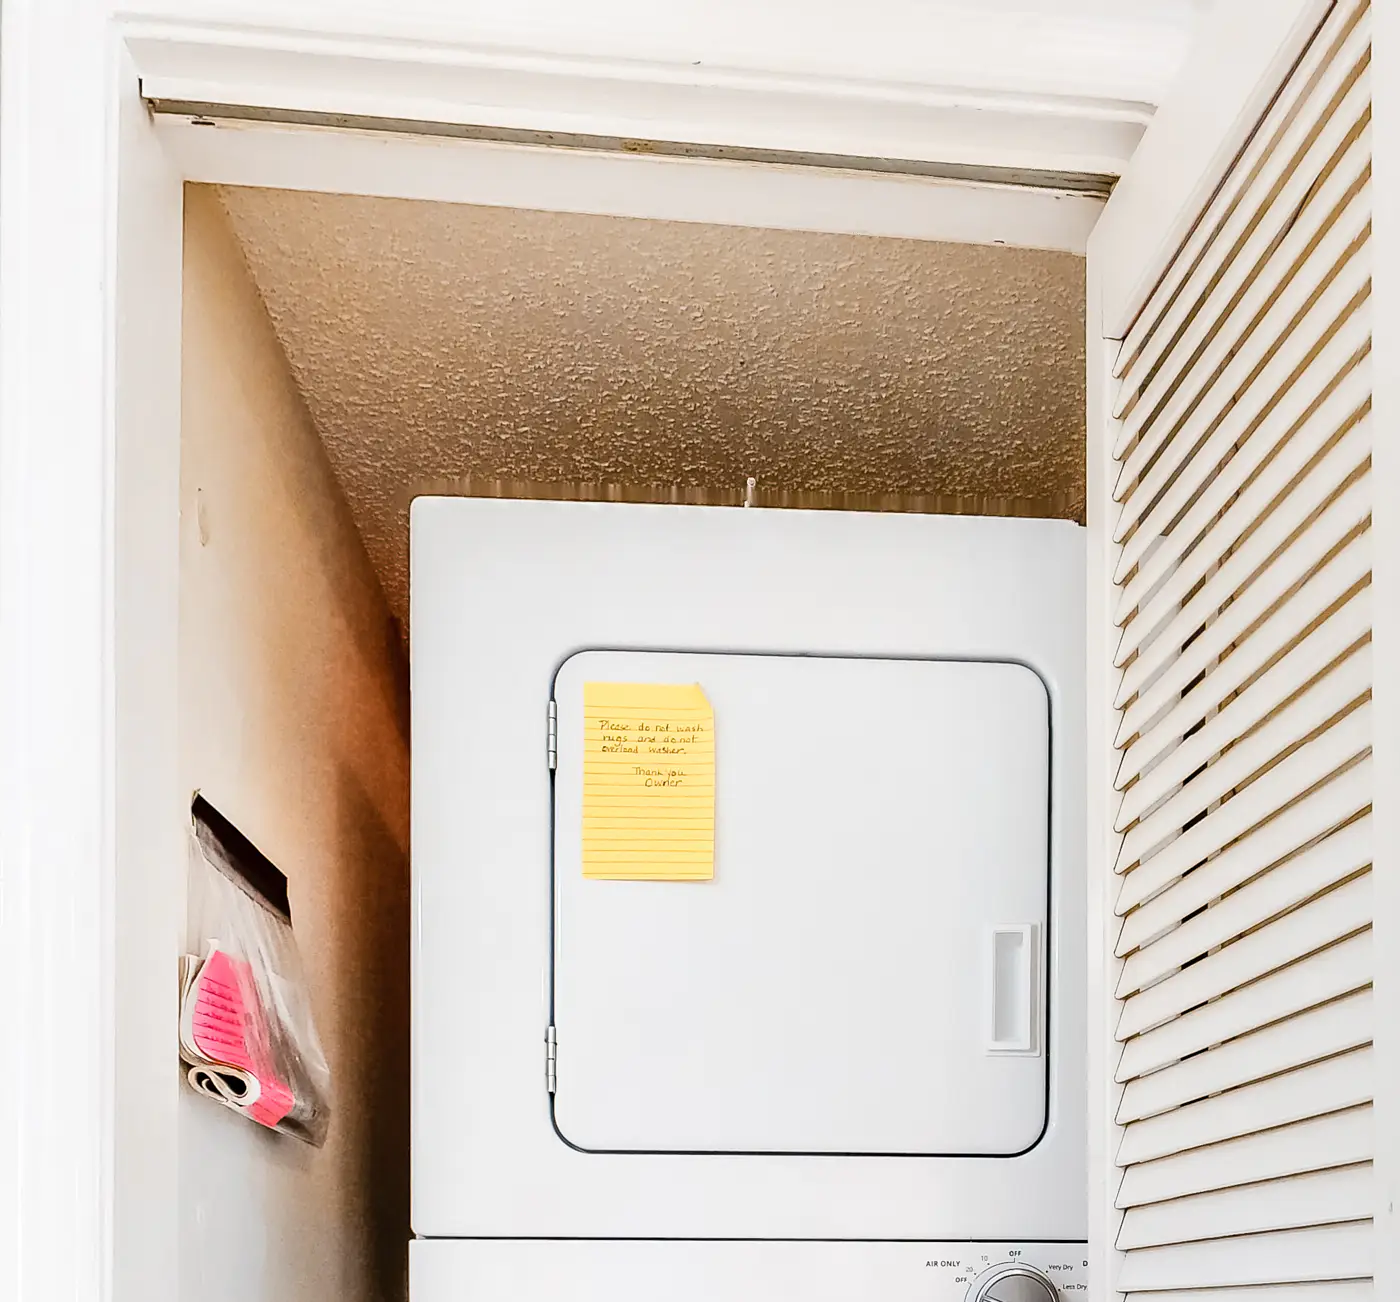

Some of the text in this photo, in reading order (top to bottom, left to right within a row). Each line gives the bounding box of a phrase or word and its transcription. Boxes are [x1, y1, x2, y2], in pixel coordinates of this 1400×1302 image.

[598, 720, 704, 732] Please do not wash
[602, 735, 698, 746] rugs and do not
[632, 766, 686, 780] Thank you
[644, 778, 683, 787] Owner
[1076, 1283, 1088, 1291] Dry
